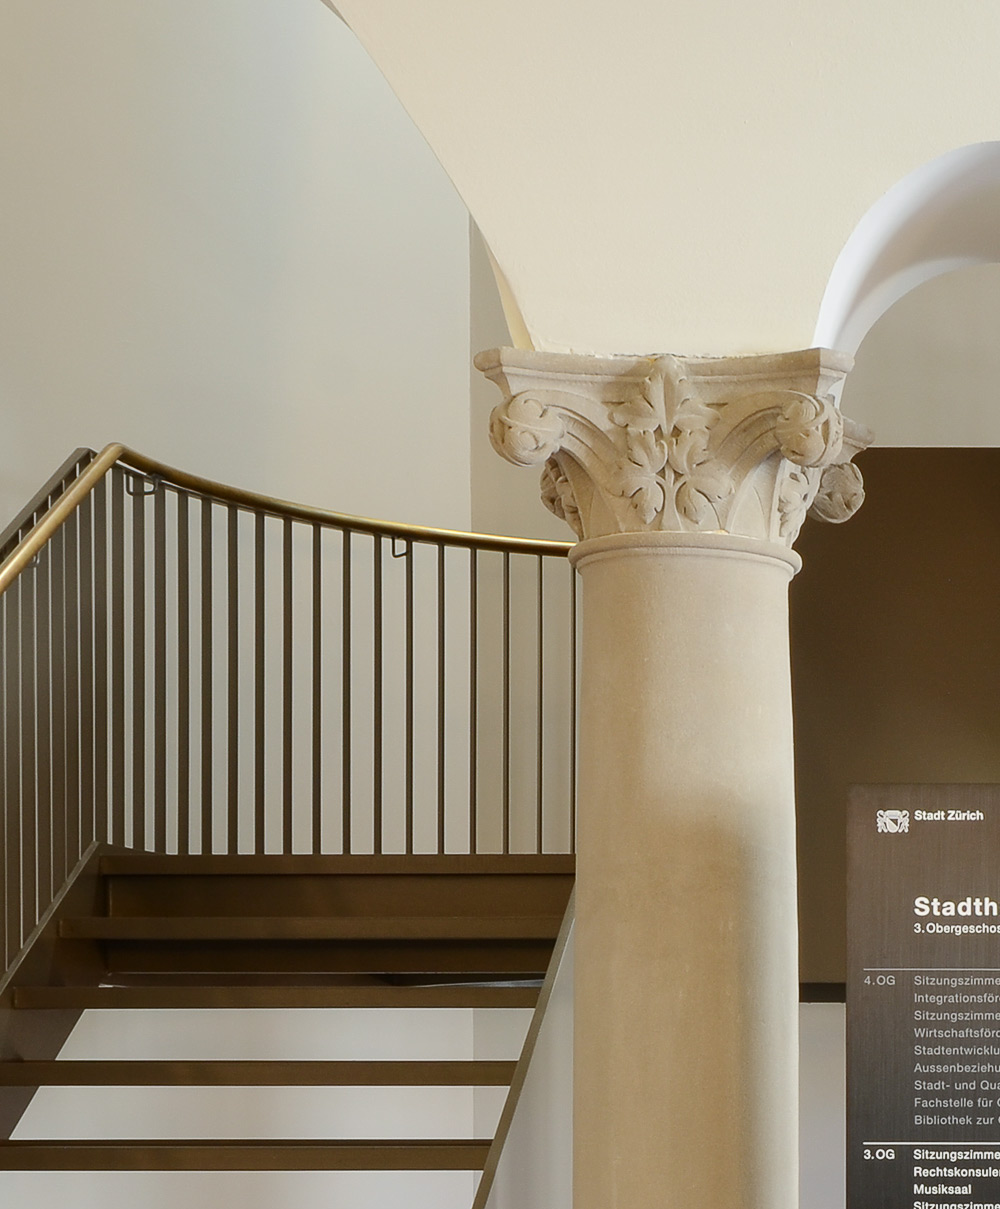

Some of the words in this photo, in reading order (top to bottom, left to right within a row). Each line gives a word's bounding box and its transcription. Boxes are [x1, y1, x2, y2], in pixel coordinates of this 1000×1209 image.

[913, 810, 946, 821] Stadt
[946, 810, 985, 821] Zürich
[914, 1080, 951, 1091] Stadt-
[954, 1081, 976, 1091] und
[914, 1098, 974, 1108] Fachstelle
[977, 1098, 994, 1108] für
[914, 1115, 973, 1126] Bibliothek
[975, 1117, 995, 1126] zur
[913, 1184, 972, 1195] Musiksaal
